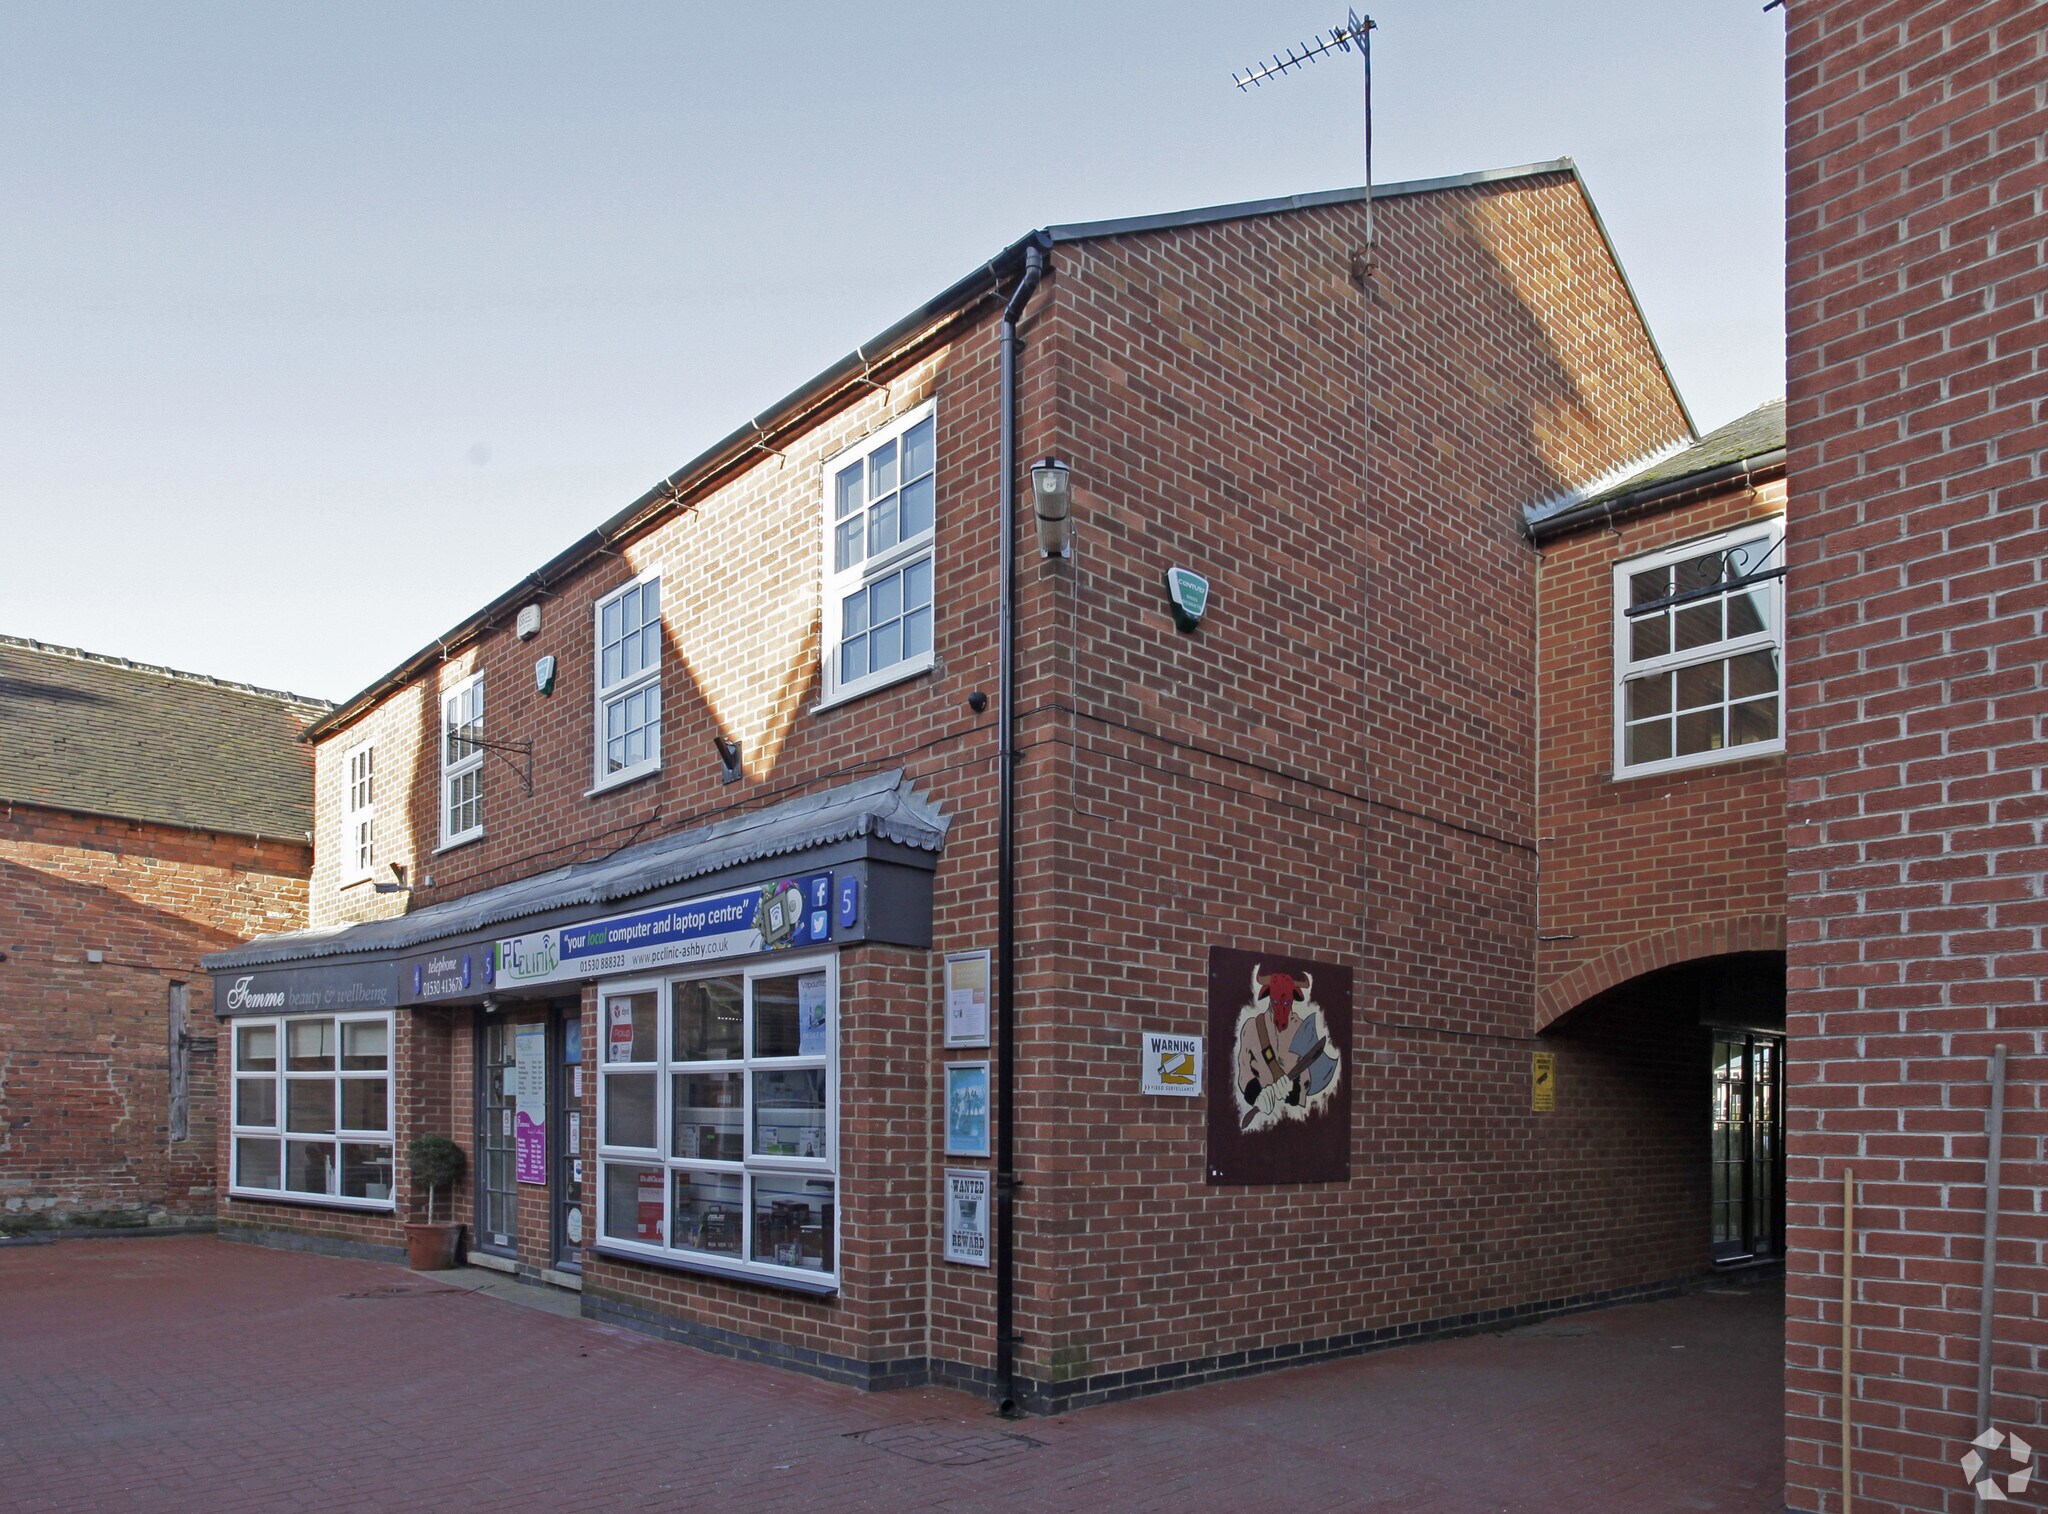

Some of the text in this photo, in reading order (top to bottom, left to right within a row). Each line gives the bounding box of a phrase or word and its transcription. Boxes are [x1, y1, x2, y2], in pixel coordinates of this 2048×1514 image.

[842, 889, 852, 914] 5
[587, 928, 608, 946] local
[608, 922, 652, 943] computer
[653, 914, 671, 935] and
[673, 911, 706, 934] laptop
[428, 955, 457, 976] telephone
[502, 938, 523, 970] PC
[580, 937, 729, 973] 01530 888323 www.pcclinic-ashby.co.uk
[227, 975, 388, 1009] Femme beauty & wellbeing
[422, 976, 463, 997] 01530 413678
[1151, 1038, 1195, 1053] WARNING
[953, 1180, 984, 1194] WANTED
[952, 1234, 984, 1249] REWARD
